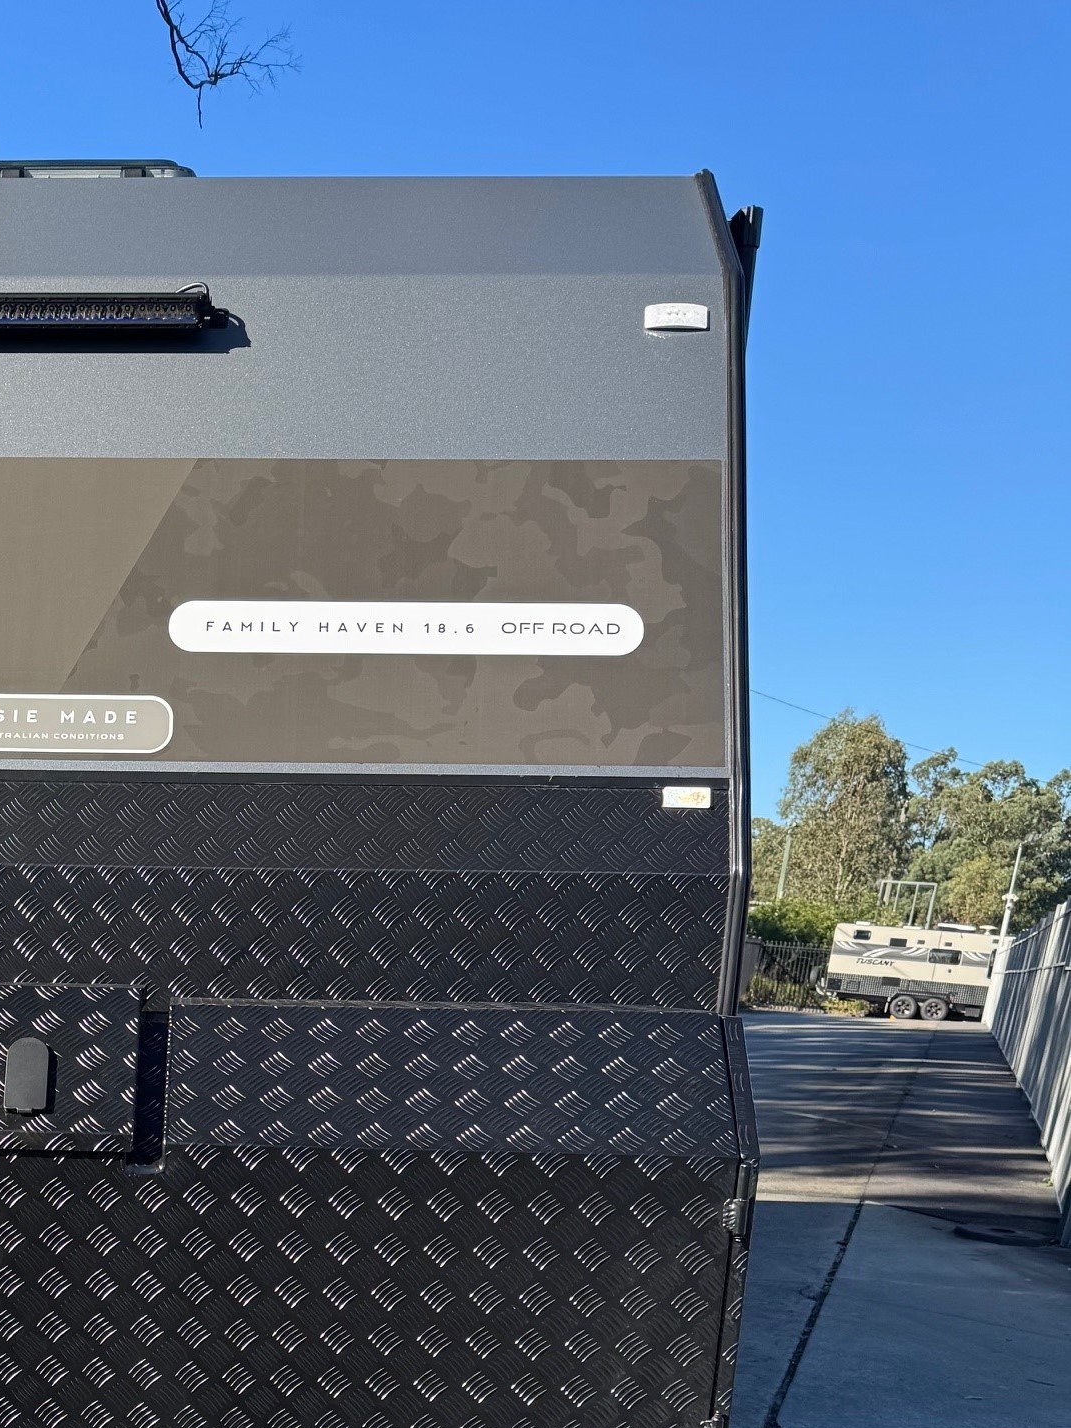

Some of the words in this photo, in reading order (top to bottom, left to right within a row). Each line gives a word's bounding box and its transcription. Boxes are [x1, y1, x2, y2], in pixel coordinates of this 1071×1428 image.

[206, 620, 300, 633] FAMILY
[318, 621, 404, 634] HAVEN
[423, 622, 475, 634] 18.6
[501, 622, 545, 635] OFF
[552, 622, 621, 635] ROAD
[60, 710, 138, 724] MADE
[53, 732, 125, 741] CONDITIONS
